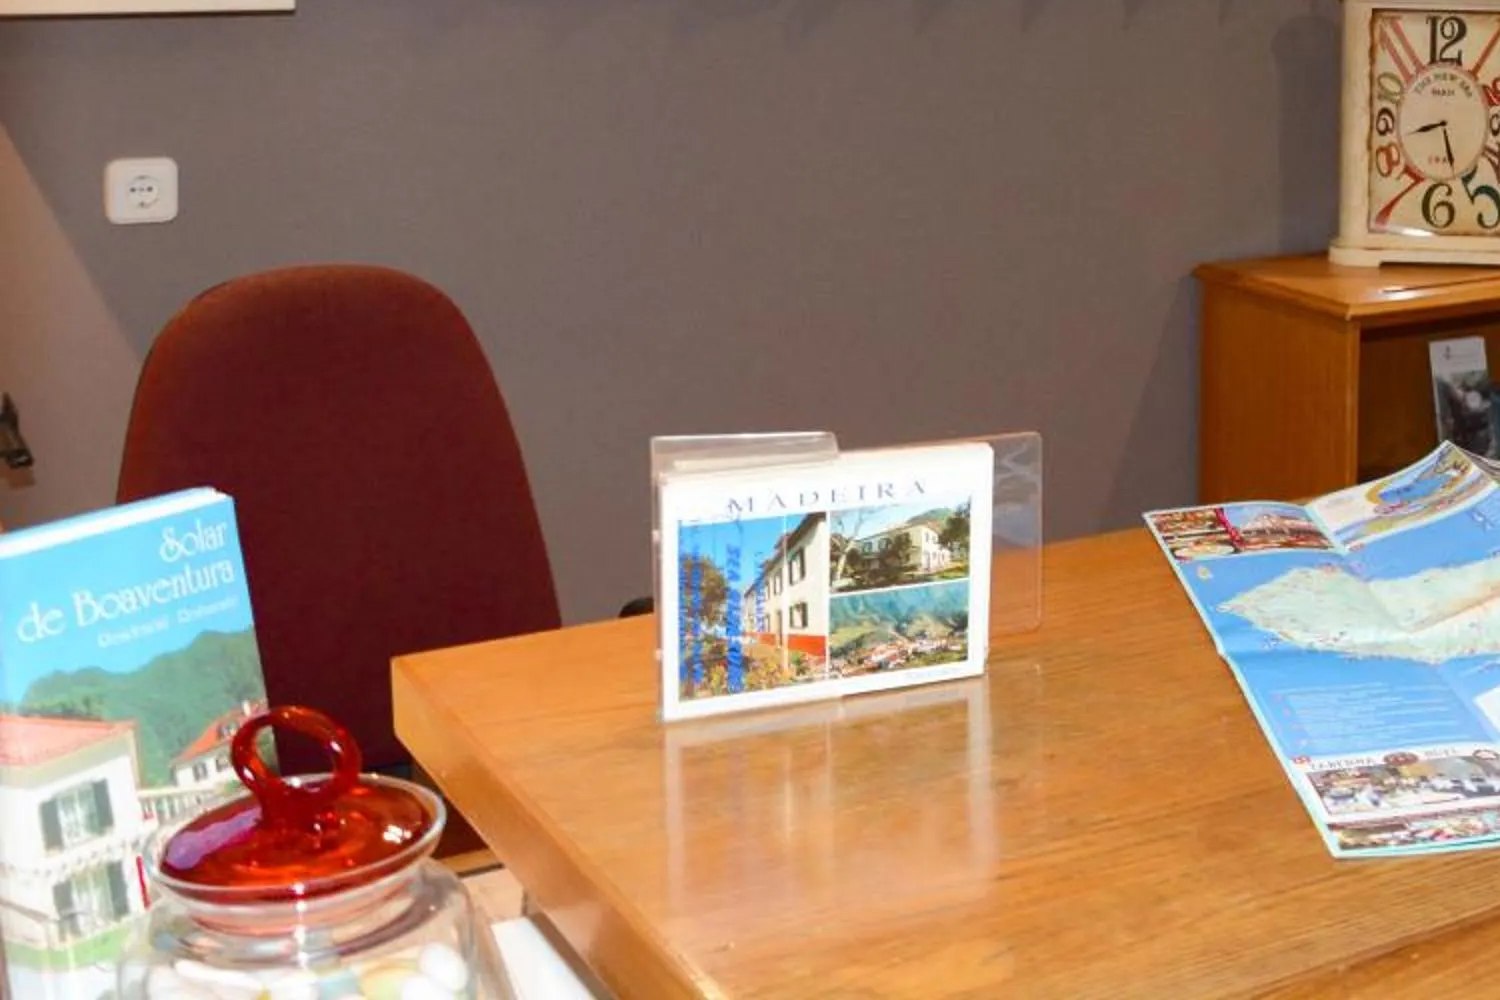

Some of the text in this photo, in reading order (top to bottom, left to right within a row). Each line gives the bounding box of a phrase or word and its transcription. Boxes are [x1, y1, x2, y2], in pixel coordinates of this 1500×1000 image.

[1425, 14, 1468, 67] 12
[1376, 107, 1395, 137] 9
[1375, 142, 1401, 178] 8
[1375, 163, 1426, 226] 7
[1421, 182, 1456, 230] 6
[726, 479, 927, 513] MADEIRA
[159, 518, 228, 564] Solar
[16, 600, 67, 643] de
[71, 558, 236, 628] Boaventura
